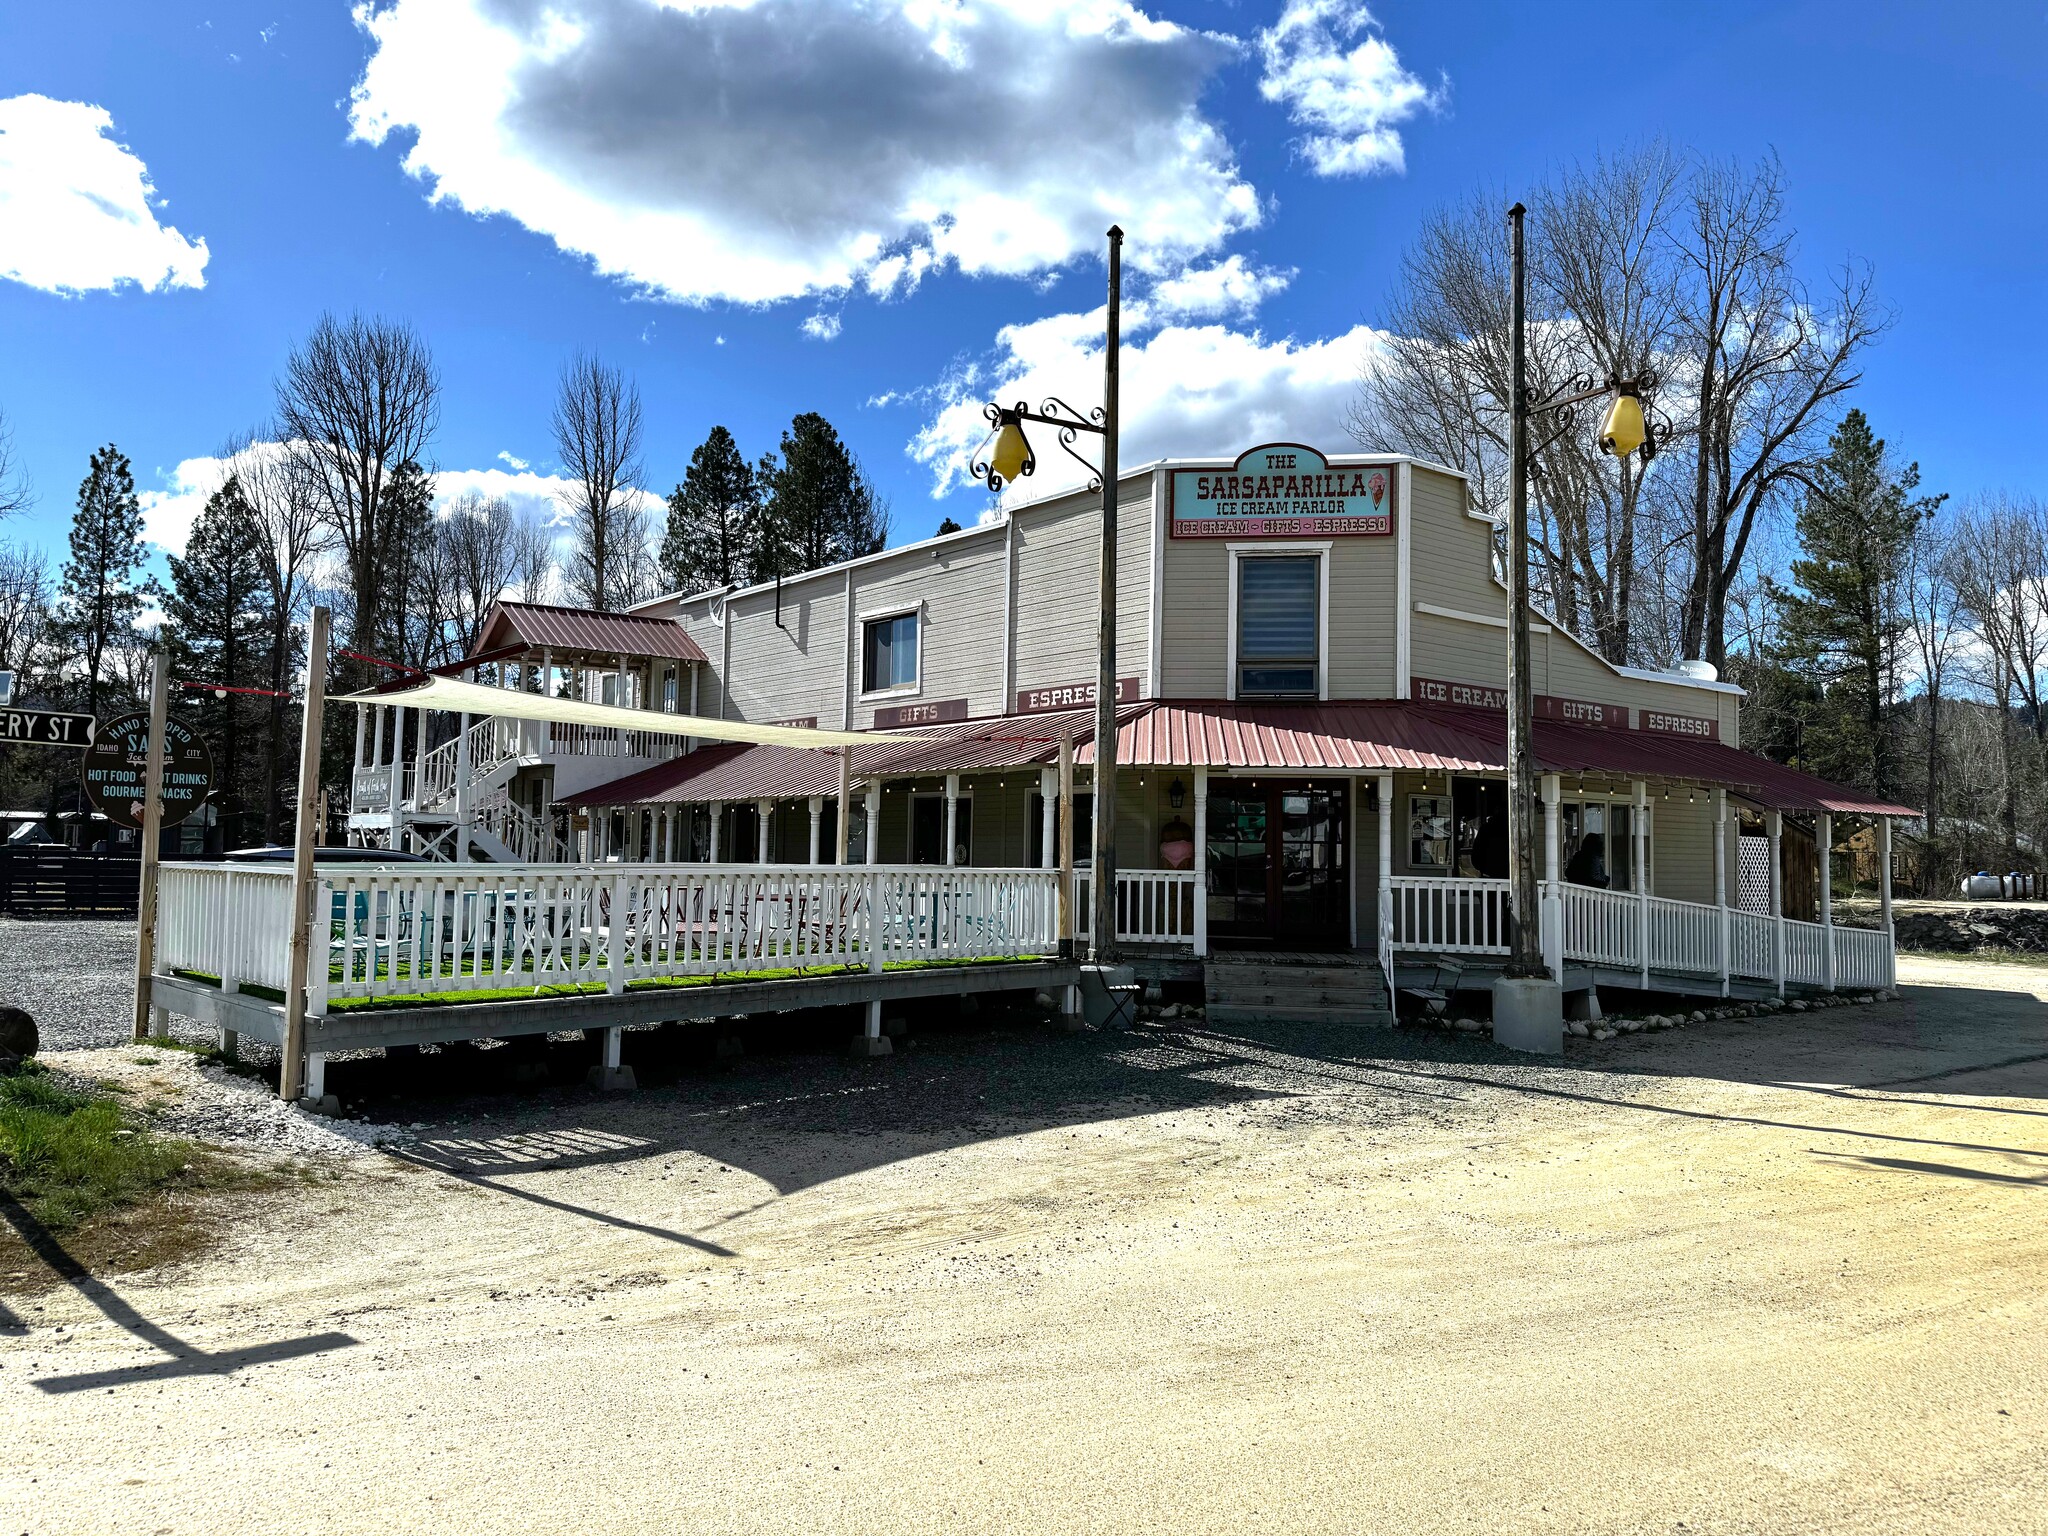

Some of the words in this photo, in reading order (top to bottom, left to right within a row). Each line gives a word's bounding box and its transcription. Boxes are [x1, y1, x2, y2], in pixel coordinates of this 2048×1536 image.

[1266, 455, 1296, 469] THE
[1197, 473, 1367, 500] SARSAPARILLA
[1217, 503, 1237, 515] ICE
[1241, 501, 1289, 515] CREAM
[1293, 500, 1345, 514] PARLOR
[1176, 521, 1198, 535] ICE
[1200, 520, 1249, 534] CREAM
[1261, 519, 1300, 533] GIFTS
[1313, 518, 1387, 533] ESPRESSO
[1029, 682, 1123, 708] ESPRESO
[1420, 681, 1447, 701] ICE
[1452, 686, 1508, 709] CREAM
[900, 705, 938, 722] GIFTS
[1563, 702, 1603, 721] GIFTS
[48, 716, 73, 741] ST
[109, 719, 140, 739] HAND
[144, 717, 191, 743] SOPED
[1648, 714, 1710, 736] ESPRESSO
[97, 744, 118, 752] IDAHO
[128, 734, 172, 753] SAS
[186, 749, 201, 757] CITY
[88, 769, 108, 782] HOT
[110, 771, 136, 782] FOOD
[173, 774, 208, 785] DRINKS
[103, 785, 144, 798] GOURME
[161, 787, 192, 799] NACKS
